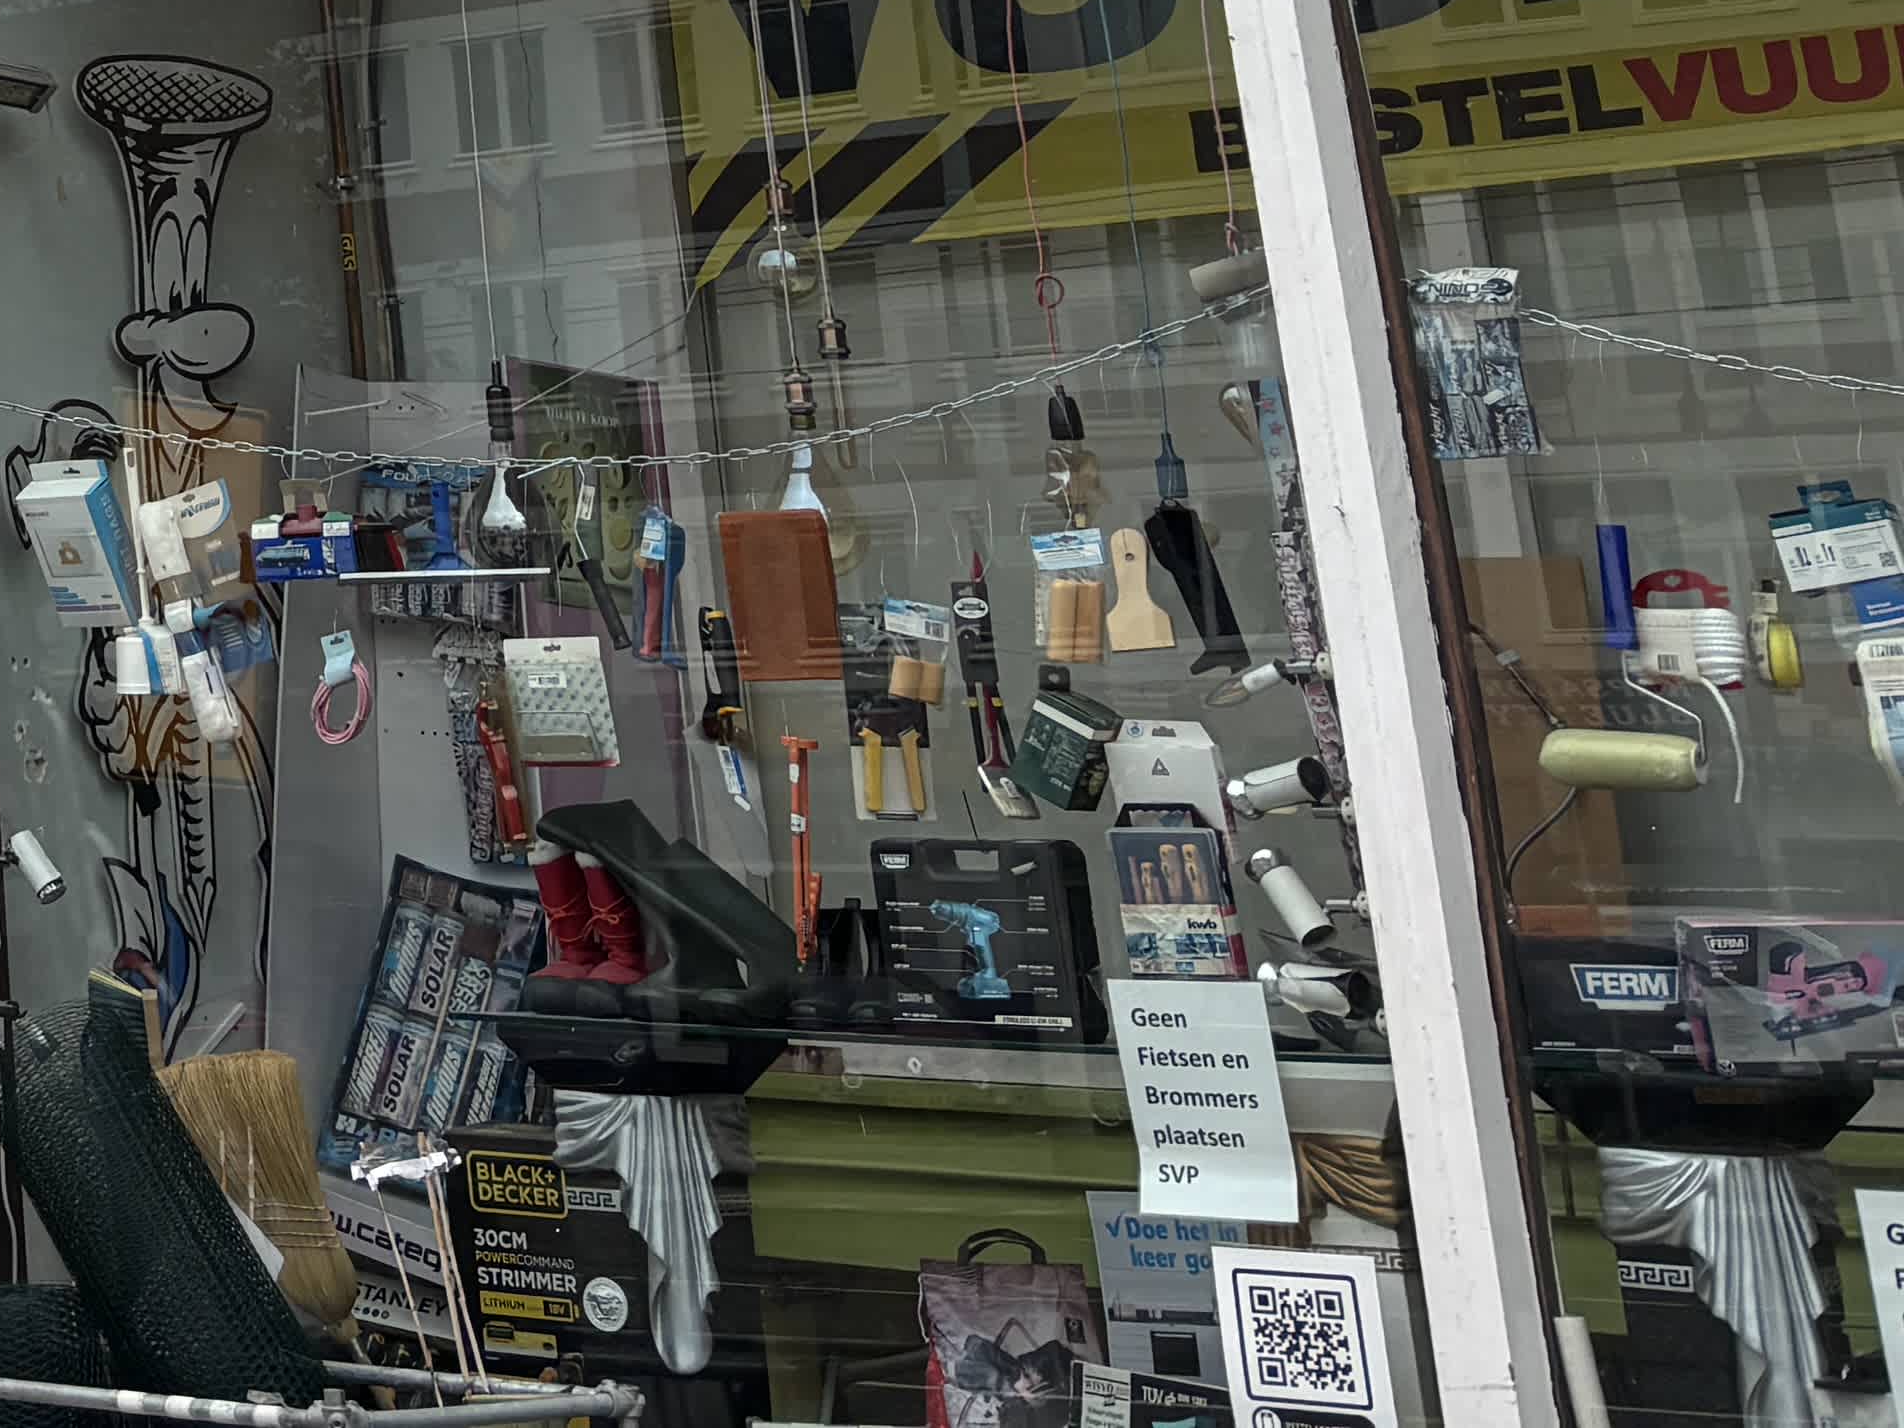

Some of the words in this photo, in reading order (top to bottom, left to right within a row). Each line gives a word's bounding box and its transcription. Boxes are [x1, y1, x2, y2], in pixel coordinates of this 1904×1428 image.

[1188, 24, 1904, 174] BSTELVUU
[1186, 916, 1219, 932] kwb
[419, 926, 457, 1010] SOLAR
[1584, 969, 1670, 997] FERM
[1130, 1005, 1189, 1030] Geen
[1137, 1045, 1217, 1070] Fietsen
[1221, 1050, 1251, 1070] en
[382, 1034, 417, 1113] SOLAR
[1145, 1085, 1260, 1111] Brommers
[1152, 1123, 1246, 1149] plaatsen
[475, 1160, 556, 1185] BLACK+
[1157, 1162, 1200, 1186] SVP
[478, 1181, 560, 1208] DECKER
[472, 1227, 528, 1250] 30CM
[1124, 1216, 1169, 1243] Doe
[474, 1250, 576, 1271] POWERCOMMAND
[1128, 1245, 1178, 1271] keer
[476, 1267, 577, 1294] STRIMMER
[482, 1296, 526, 1311] LITHIUM
